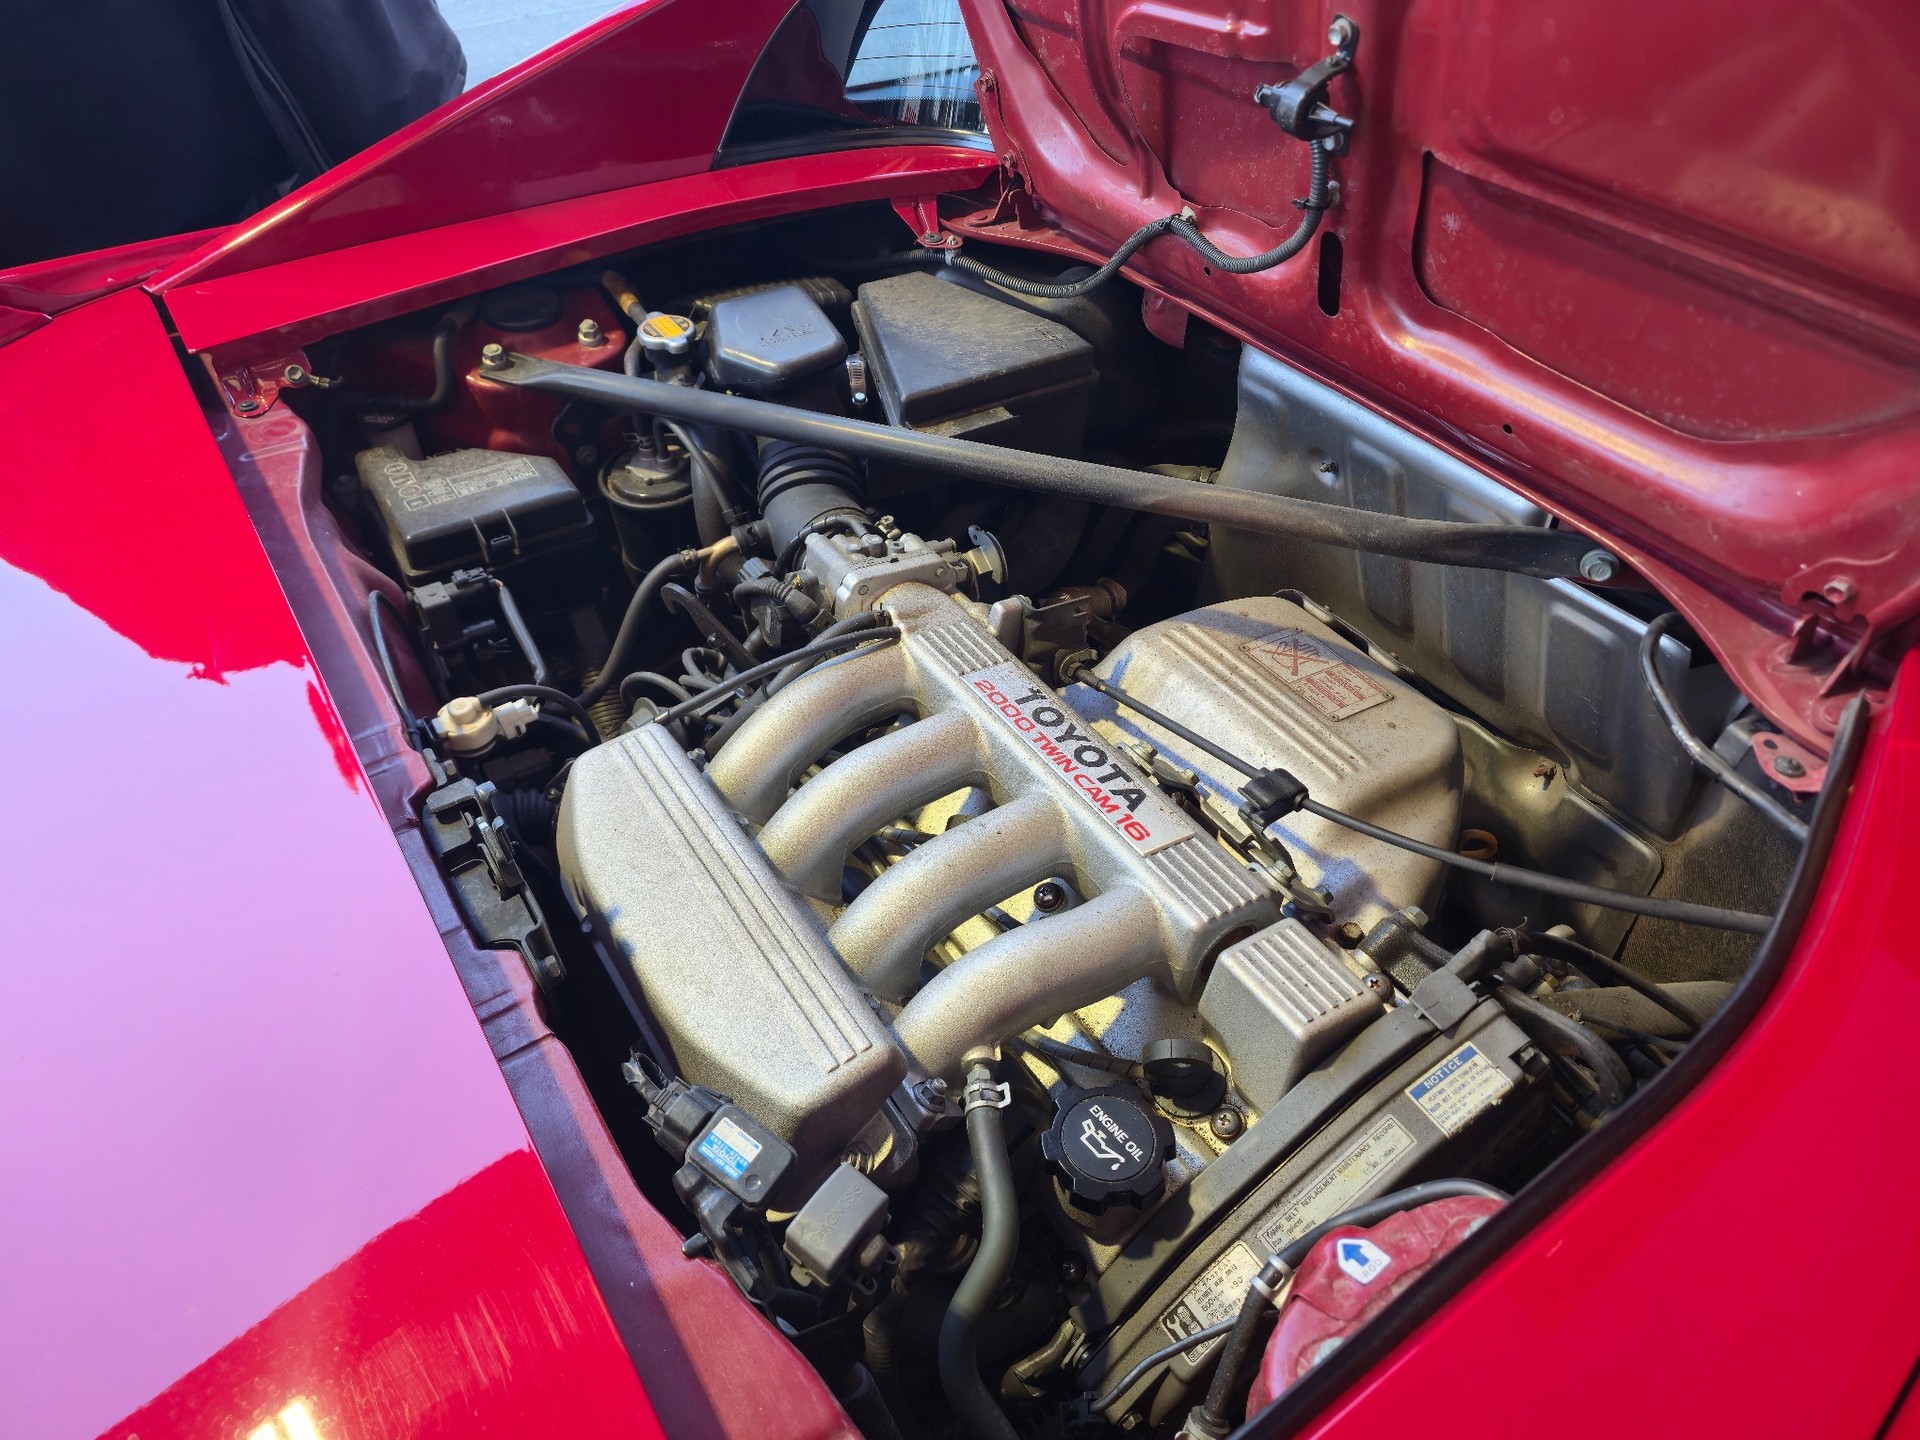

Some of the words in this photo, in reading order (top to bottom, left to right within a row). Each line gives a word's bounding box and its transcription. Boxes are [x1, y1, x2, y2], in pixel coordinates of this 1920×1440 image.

[974, 680, 1036, 732] 2000
[1032, 732, 1079, 773] TWIN
[1073, 774, 1121, 814] CAM
[1115, 813, 1151, 841] 16
[1015, 687, 1147, 812] TOYOTA
[1423, 1057, 1463, 1089] NOTICE
[712, 1145, 737, 1168] TOYOTA
[1089, 1104, 1129, 1143] ENGINE
[1125, 1141, 1144, 1162] OIL
[1285, 1207, 1299, 1222] BELT
[1301, 1173, 1338, 1207] REPLACEMENT
[1337, 1143, 1372, 1175] MAINTENANCE
[809, 1184, 864, 1247] DIAGNOSIS
[1361, 1258, 1383, 1279] ROD
